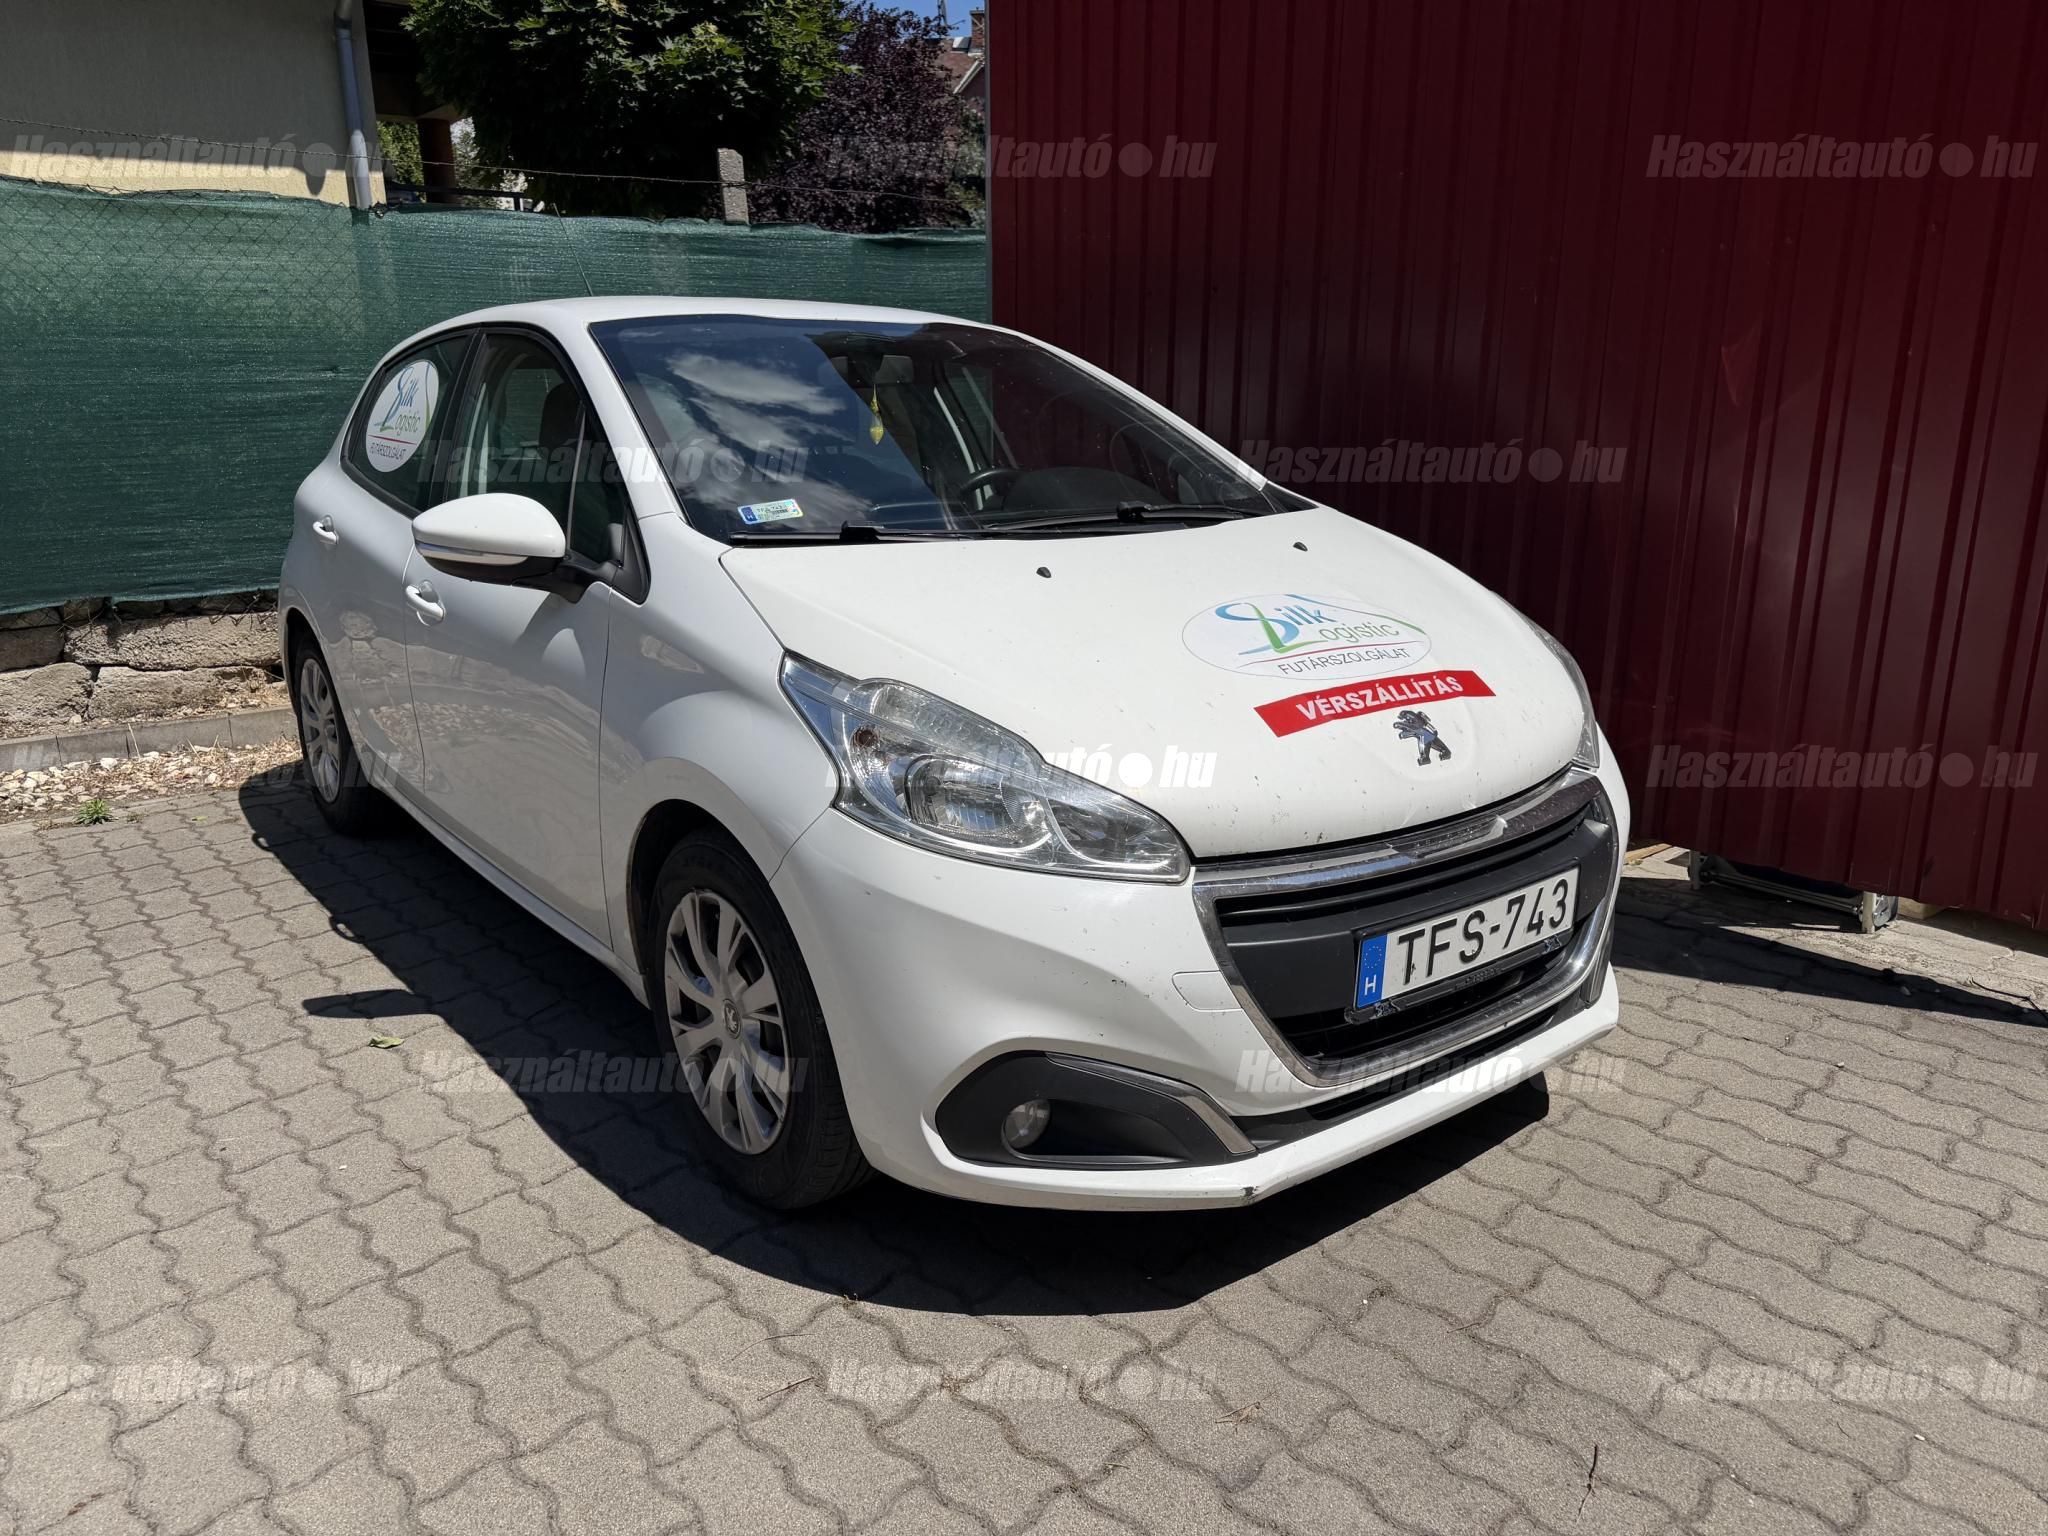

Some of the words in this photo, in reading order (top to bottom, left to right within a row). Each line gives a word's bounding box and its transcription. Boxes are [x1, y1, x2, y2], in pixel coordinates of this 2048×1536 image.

[1215, 600, 1338, 654] Silk
[1278, 647, 1412, 675] FUTÁRSZOLGÁLAT
[1296, 675, 1464, 722] VÉRSZÁLLÍTÁS
[1398, 878, 1569, 986] TFS-743
[1364, 975, 1377, 996] H
